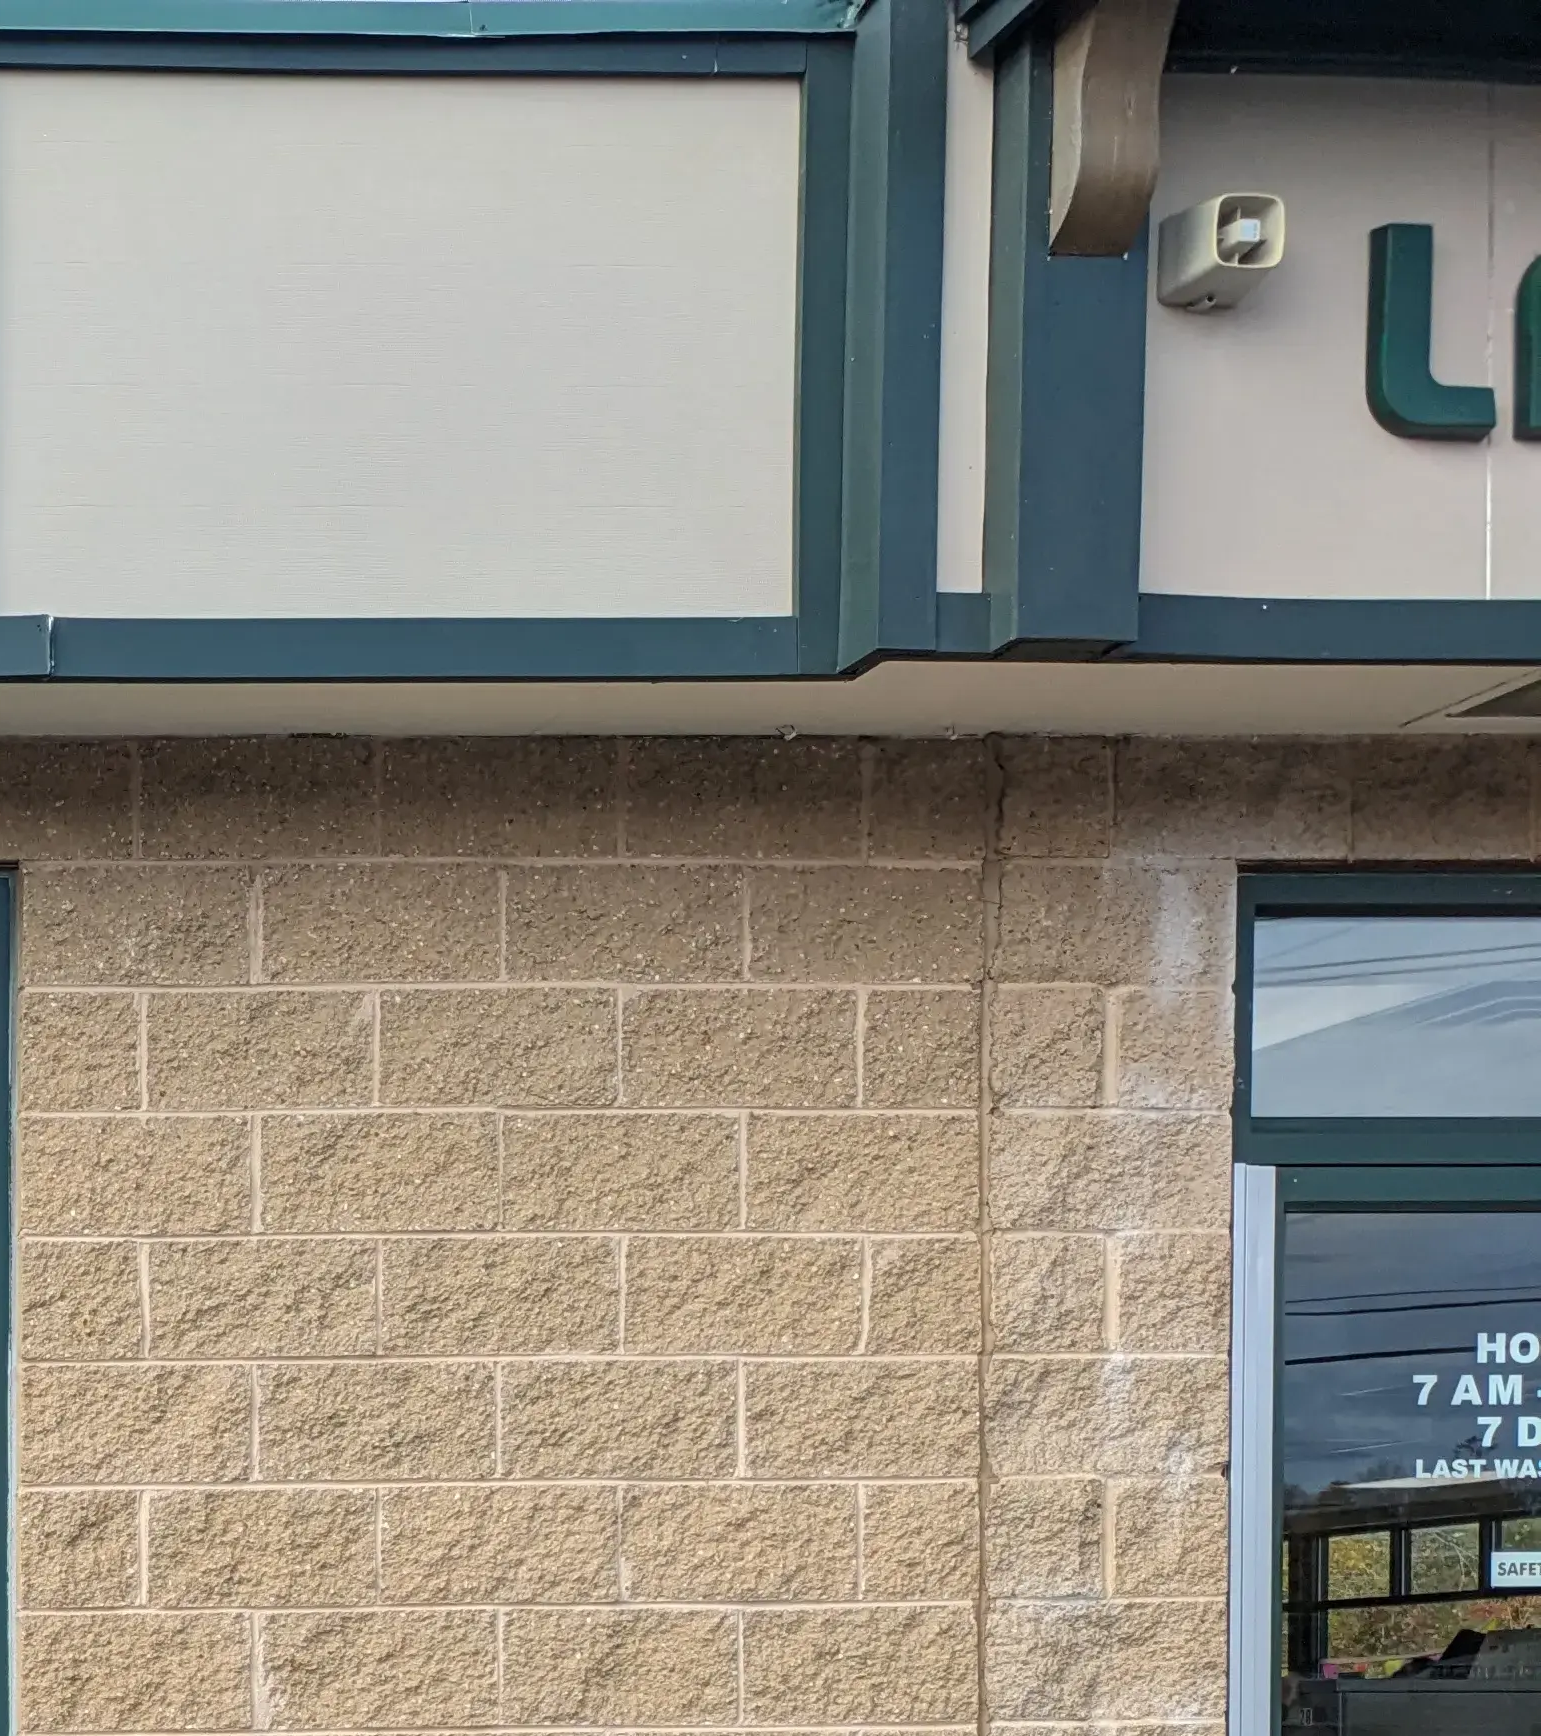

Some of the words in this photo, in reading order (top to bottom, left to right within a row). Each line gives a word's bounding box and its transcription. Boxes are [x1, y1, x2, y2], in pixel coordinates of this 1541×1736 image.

[1412, 1374, 1438, 1406] 7
[1450, 1374, 1522, 1406] AM
[1476, 1416, 1502, 1447] 7
[1415, 1458, 1487, 1480] LAST
[1493, 1458, 1541, 1480] WA
